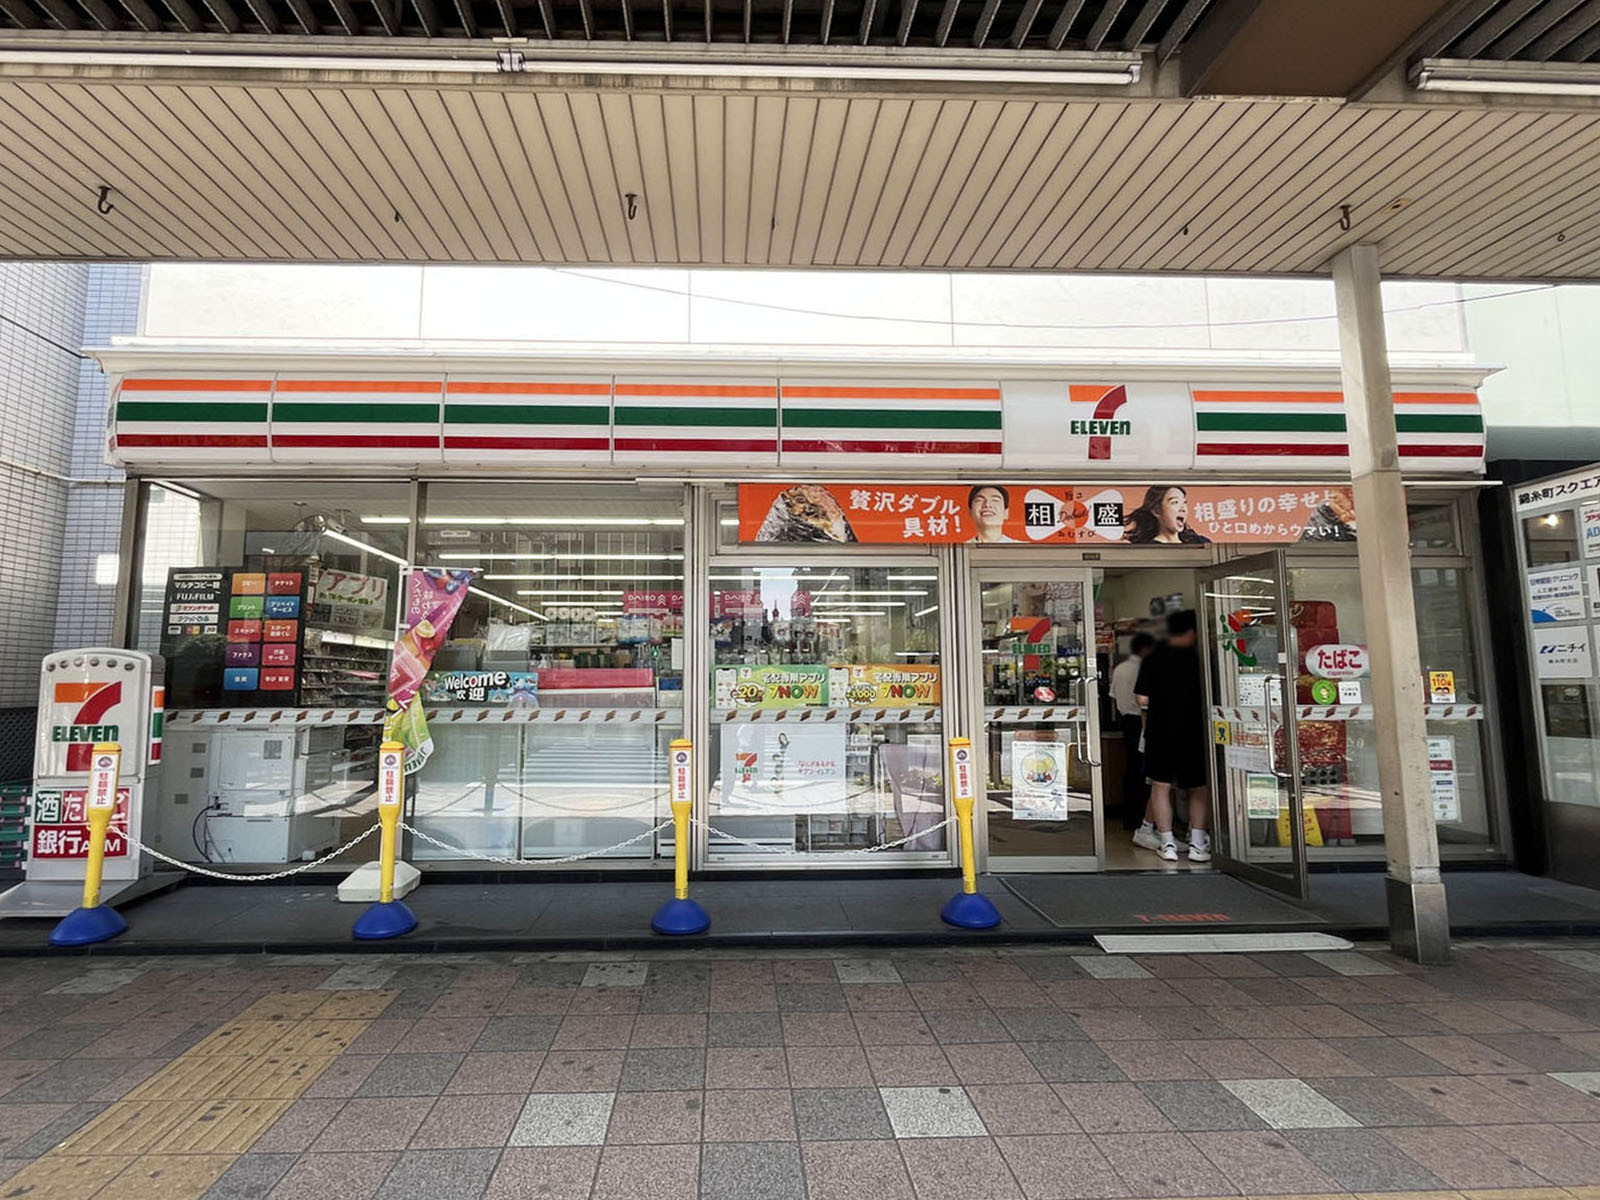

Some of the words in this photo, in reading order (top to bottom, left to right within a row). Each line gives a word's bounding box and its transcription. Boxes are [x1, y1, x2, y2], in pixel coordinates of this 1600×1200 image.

[1069, 384, 1127, 459] 7
[849, 489, 961, 515] 贅沢ダブル
[902, 514, 962, 539] 具材!
[1028, 504, 1052, 525] 相
[1097, 504, 1120, 526] 盛
[1208, 522, 1340, 538] ひと口めからウマい!
[1317, 649, 1363, 669] たばこ
[444, 670, 508, 691] Welcome
[36, 792, 61, 823] 酒
